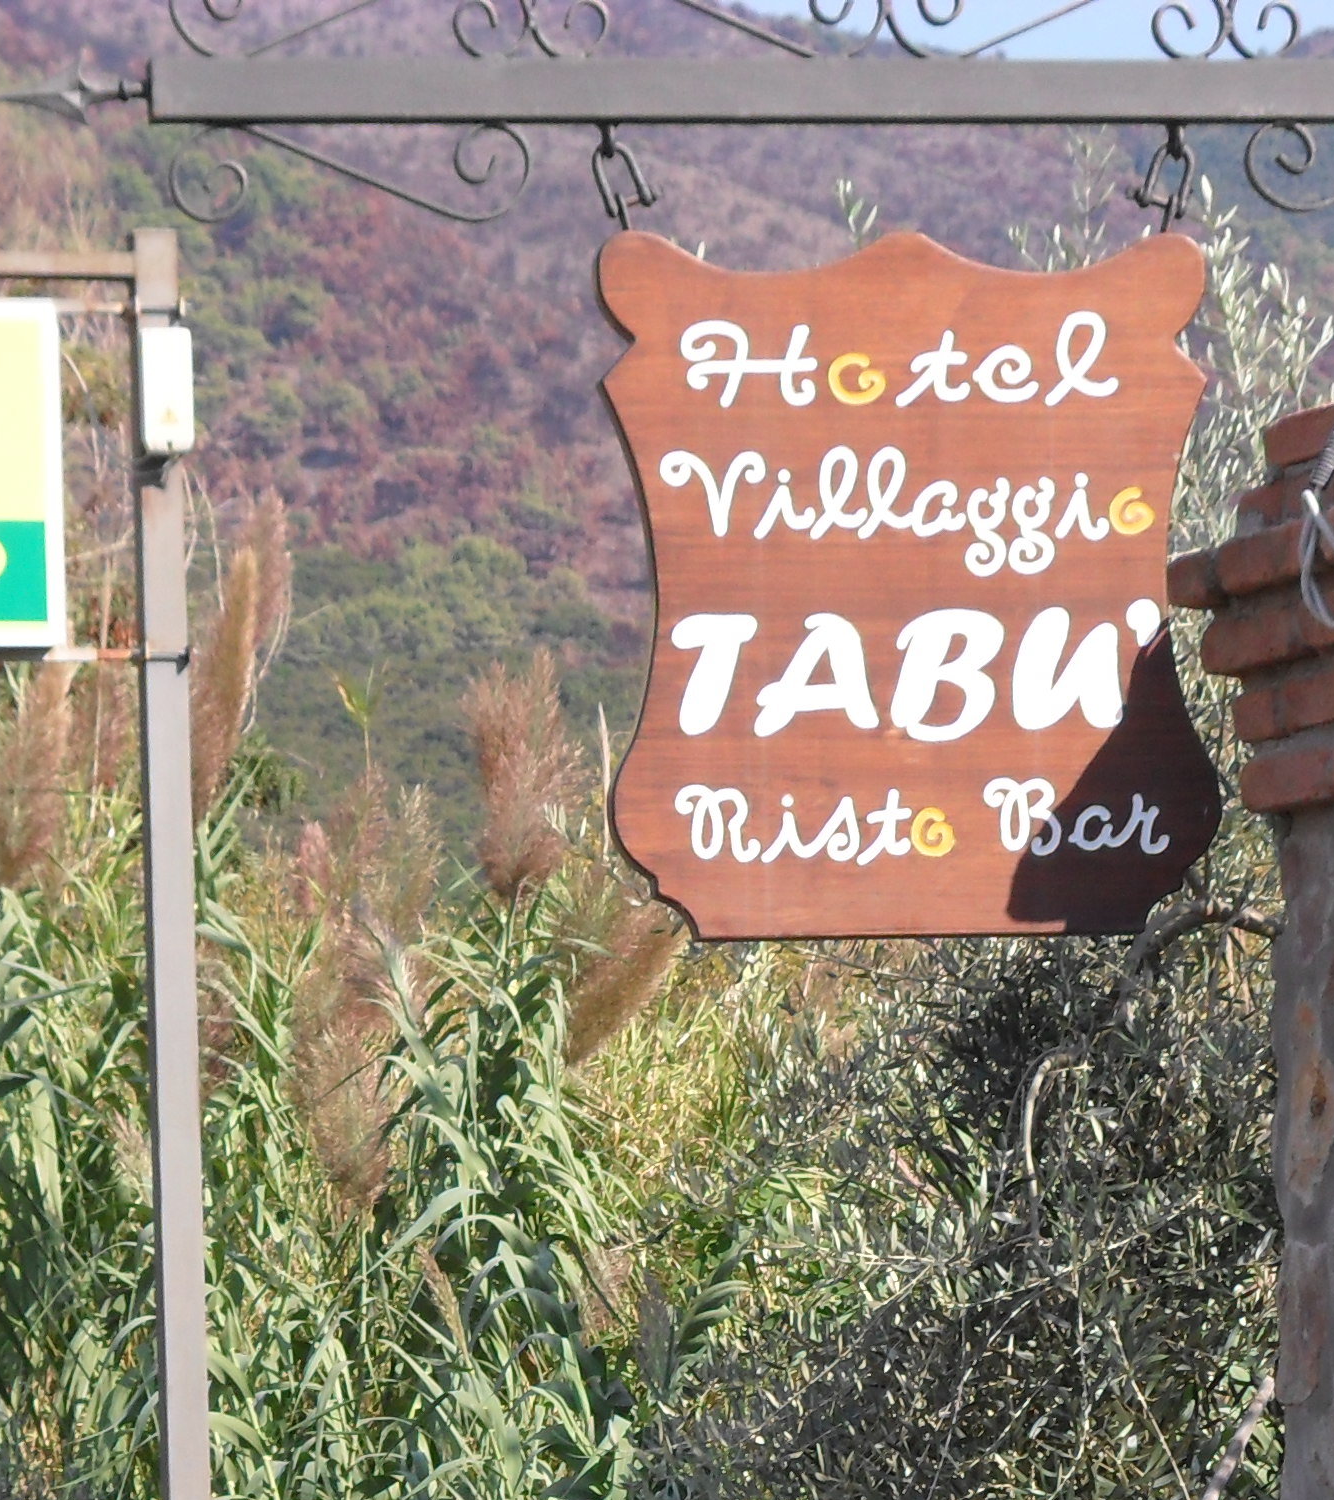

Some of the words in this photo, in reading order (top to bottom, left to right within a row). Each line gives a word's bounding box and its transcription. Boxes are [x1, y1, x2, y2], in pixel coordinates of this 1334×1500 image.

[679, 310, 1120, 408] Hotel
[659, 445, 1156, 577] Villaggio
[674, 783, 956, 866] Risto
[983, 777, 1170, 858] Bar
